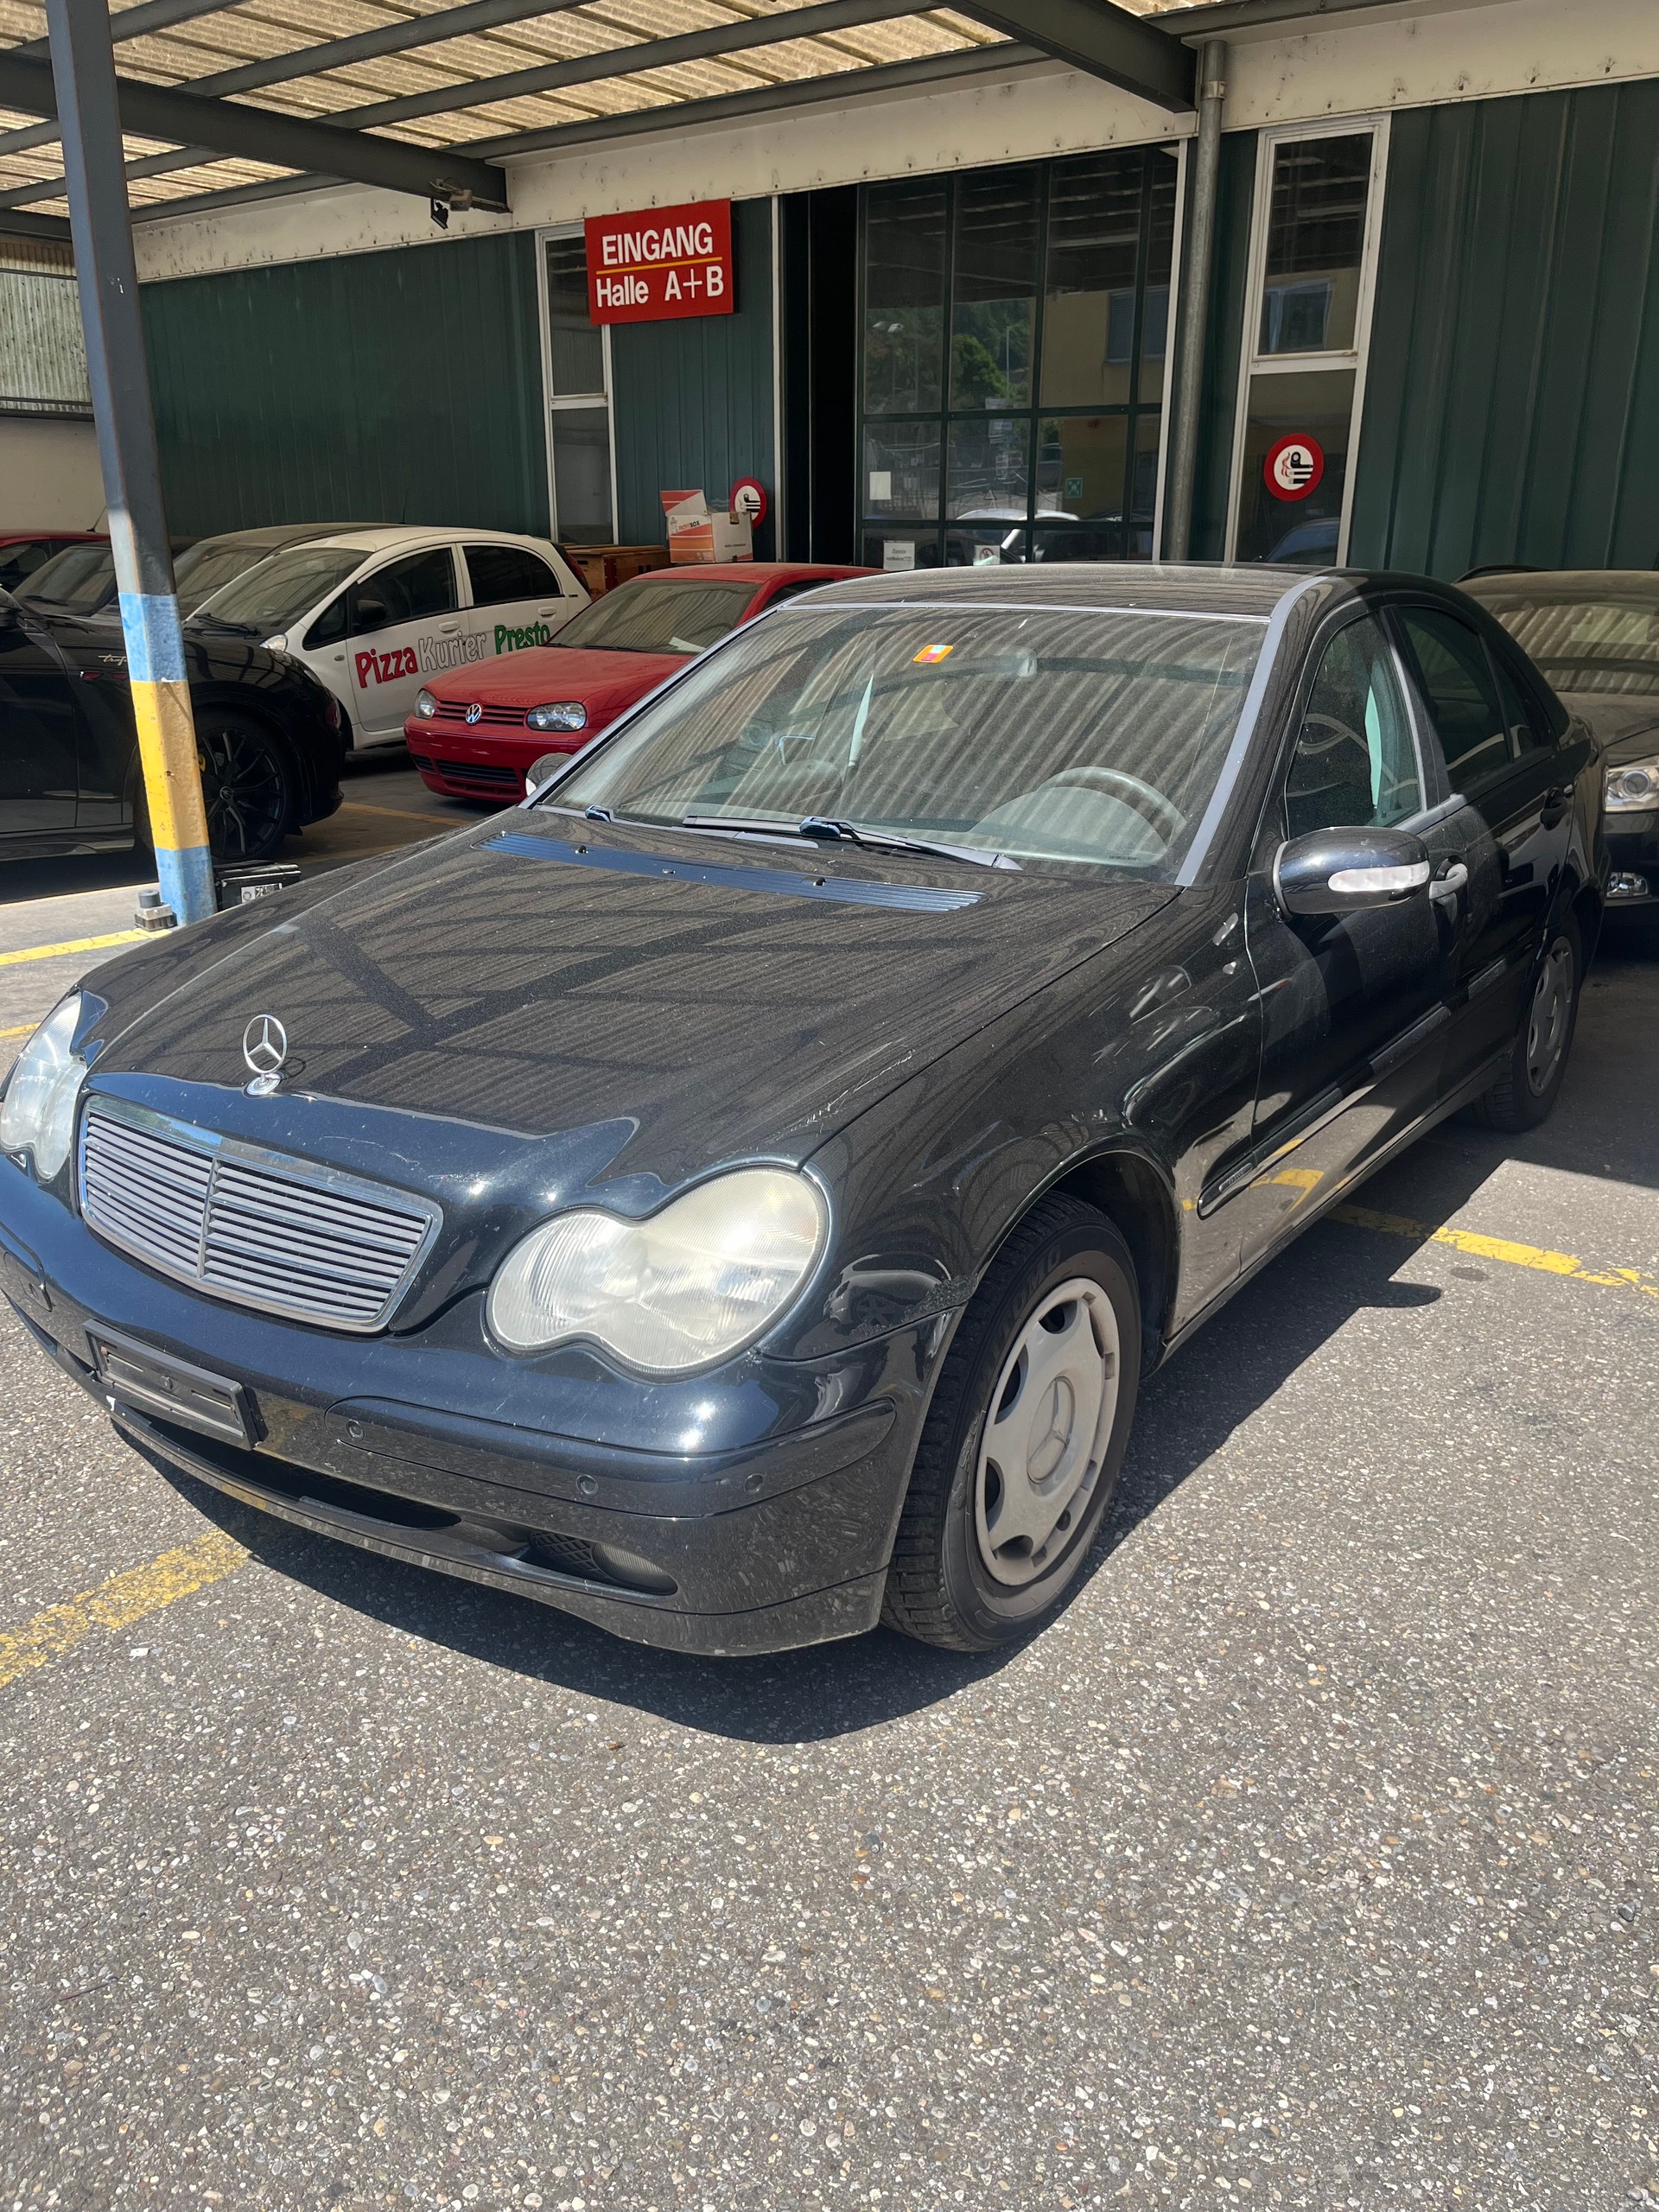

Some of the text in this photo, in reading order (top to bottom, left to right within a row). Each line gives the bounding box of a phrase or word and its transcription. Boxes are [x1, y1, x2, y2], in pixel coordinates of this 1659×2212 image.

[602, 222, 713, 265] EINGANG
[596, 265, 724, 308] Halle A+B
[355, 620, 550, 689] Pizza Kurier Presto
